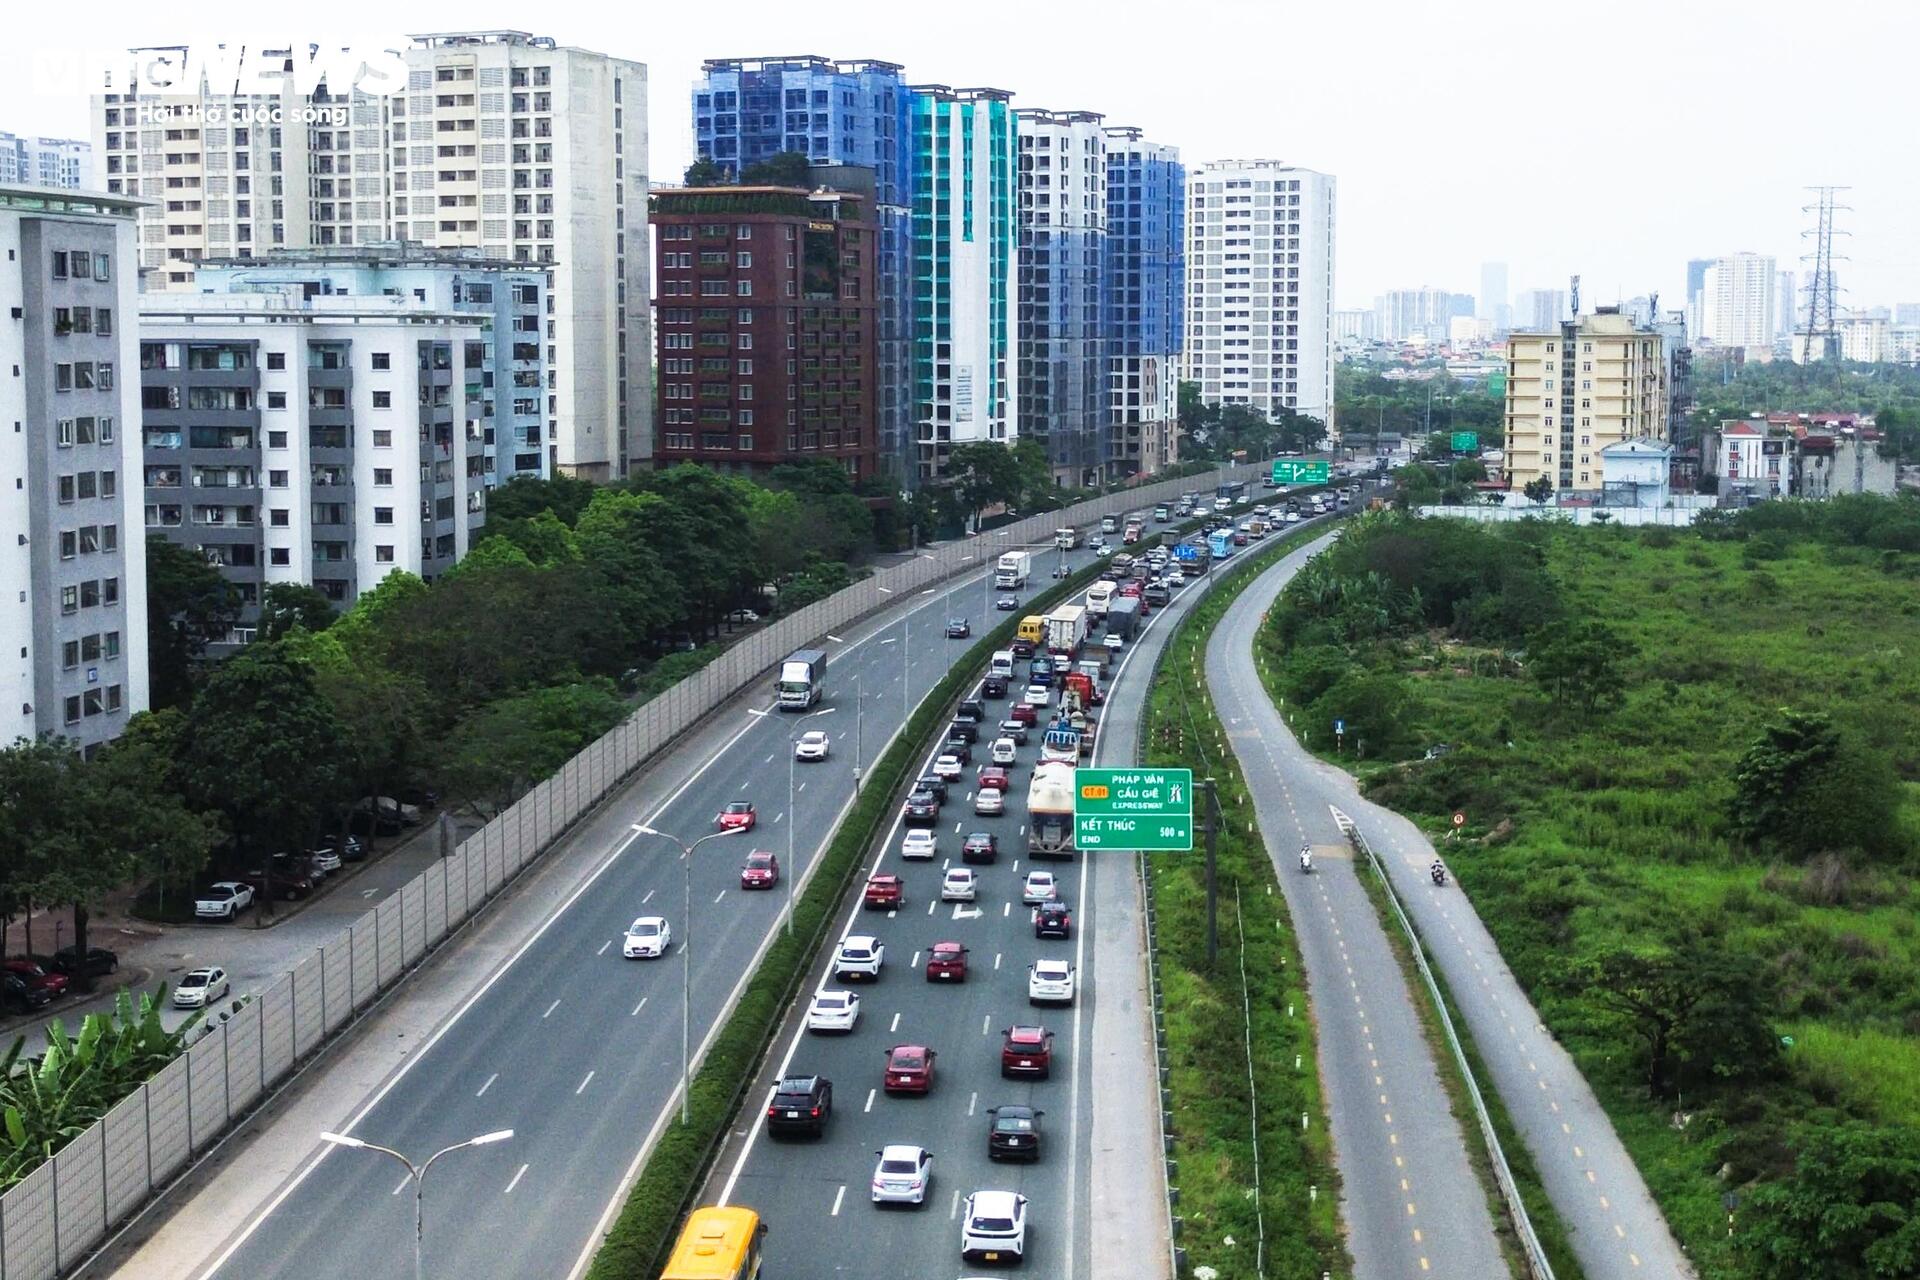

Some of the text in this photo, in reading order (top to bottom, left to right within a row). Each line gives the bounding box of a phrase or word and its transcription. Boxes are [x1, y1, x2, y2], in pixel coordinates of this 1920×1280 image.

[1112, 772, 1141, 784] PHÁP
[1107, 817, 1136, 831] THÚC
[1159, 827, 1175, 838] 500
[1081, 835, 1101, 844] END
